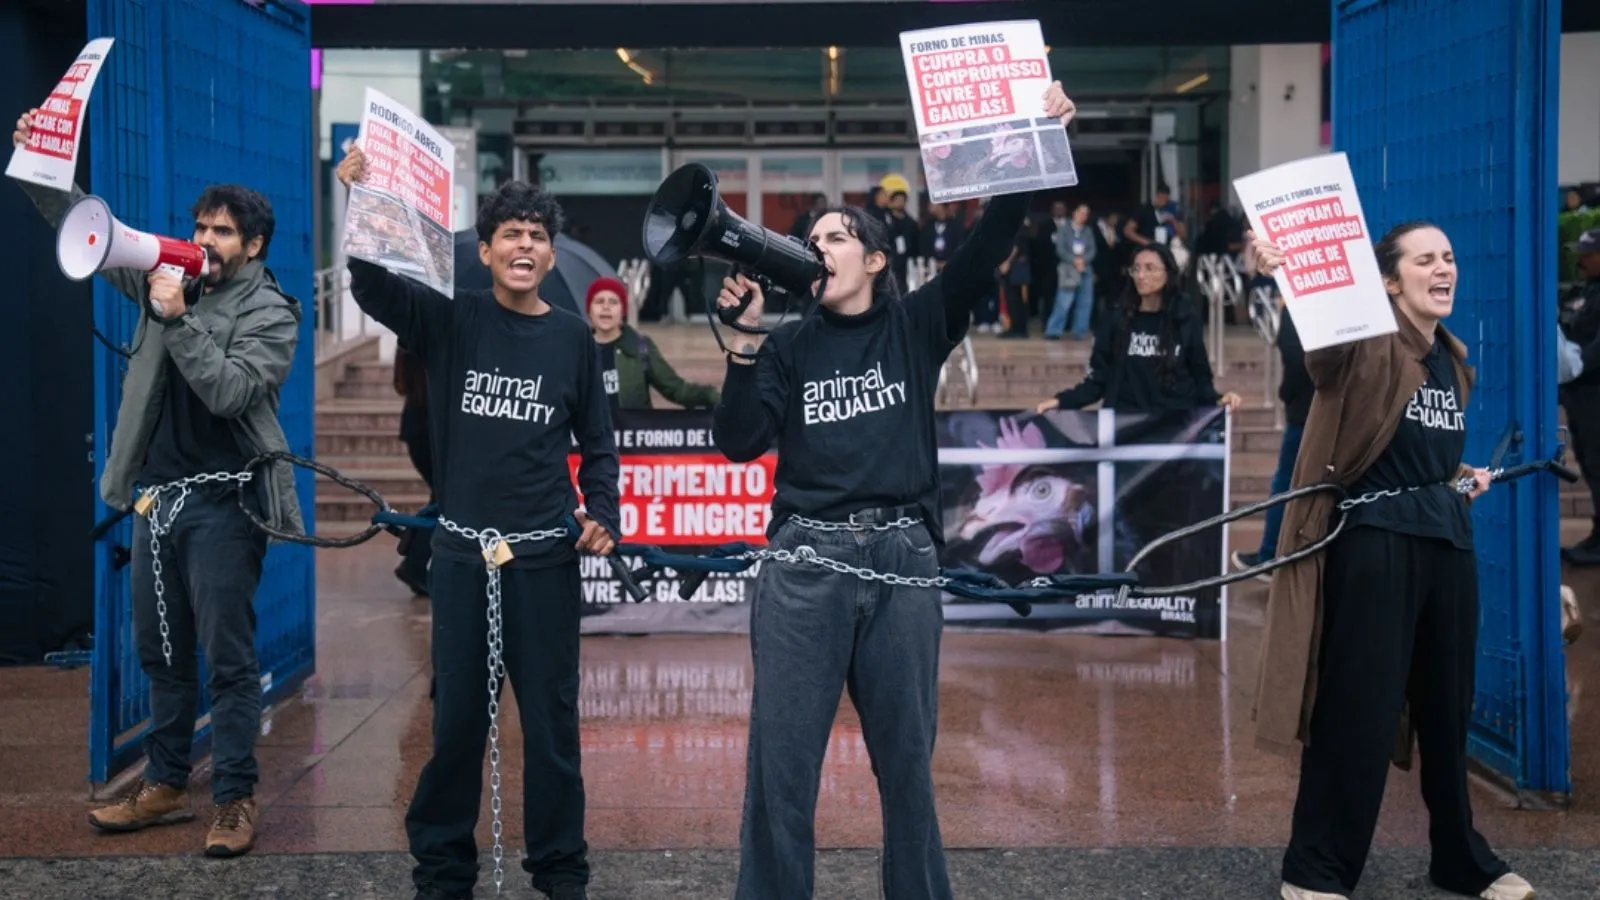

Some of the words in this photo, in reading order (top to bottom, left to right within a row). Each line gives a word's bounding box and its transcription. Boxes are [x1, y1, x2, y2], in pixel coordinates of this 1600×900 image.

[909, 39, 948, 54] FORNO
[951, 37, 965, 48] DE
[968, 33, 1005, 45] MINAS
[918, 50, 986, 72] CUMPRA
[992, 48, 1005, 62] O
[921, 62, 1043, 88] COMPROMISSO
[925, 84, 976, 106] LIVRE
[979, 82, 1003, 97] DE
[928, 98, 1010, 123] GAIOLAS!
[58, 118, 73, 135] COM
[370, 102, 415, 135] RODRIGO
[414, 129, 443, 161] ABREU,
[1267, 203, 1332, 232] CUMPRAM
[1333, 202, 1343, 217] O
[1276, 221, 1361, 250] COMPROMISSO
[1285, 248, 1325, 271] LIVRE
[1325, 245, 1342, 261] DE
[1293, 266, 1350, 291] GAIOLAS!
[464, 367, 542, 400] animal
[803, 361, 885, 403] animal
[461, 392, 555, 425] EQUALITY
[803, 381, 906, 425] EQUALITY
[623, 429, 634, 447] E
[636, 429, 684, 447] FORNO
[686, 429, 706, 447] DE
[617, 463, 767, 497] FRIMENTO
[646, 496, 666, 536] É
[655, 579, 745, 603] GALAS!
